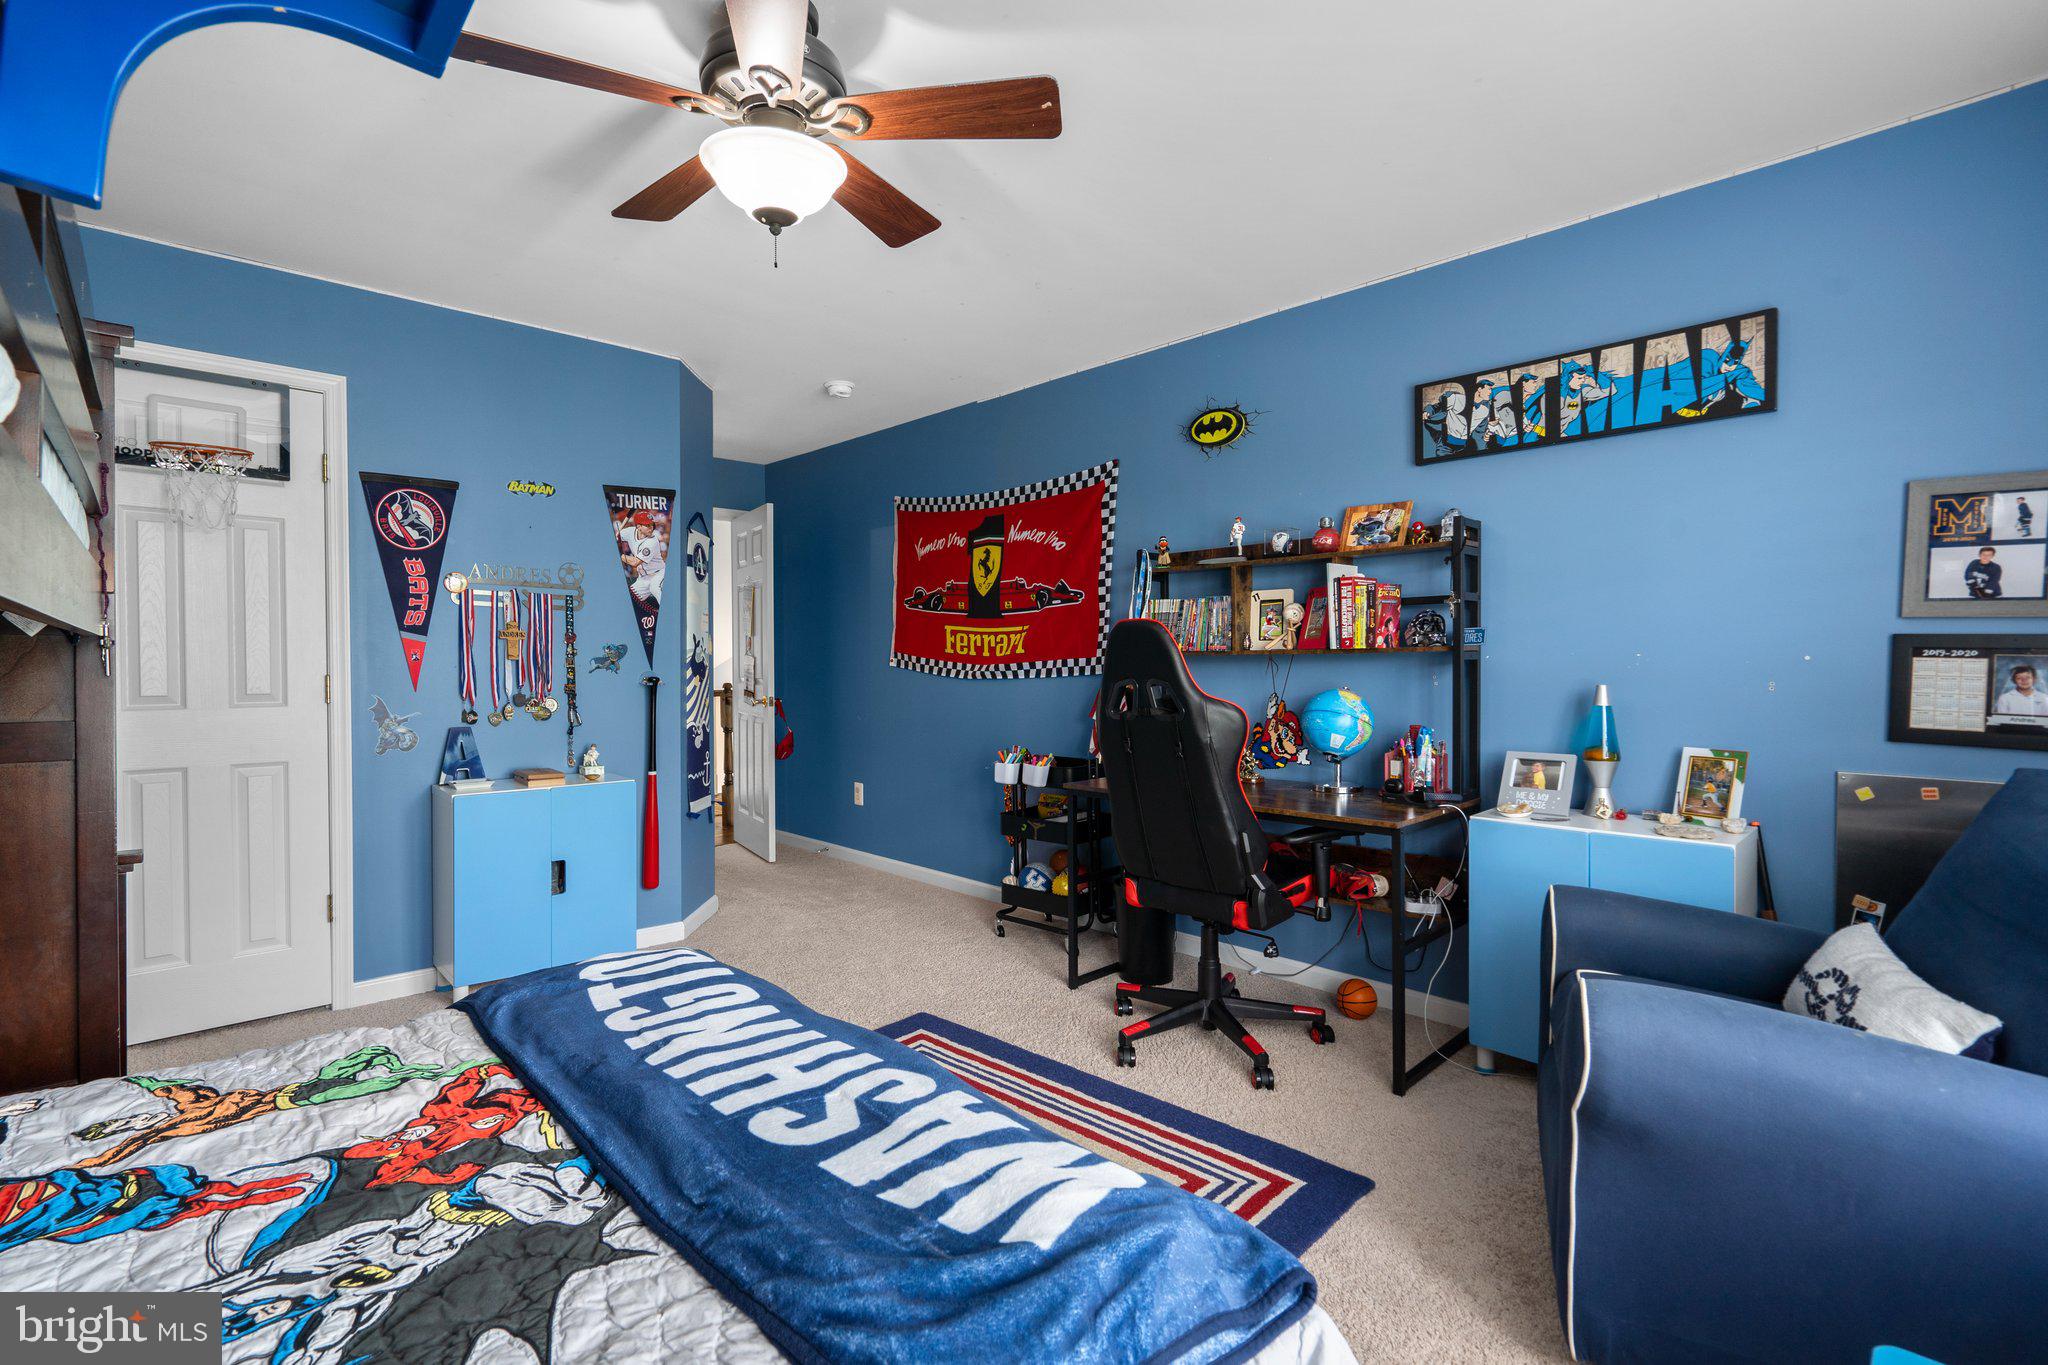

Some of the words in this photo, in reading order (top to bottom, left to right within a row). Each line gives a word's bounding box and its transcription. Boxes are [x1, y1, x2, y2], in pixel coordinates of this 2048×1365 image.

[1422, 315, 1766, 459] BATMAN
[508, 481, 554, 495] BATMAN
[412, 492, 443, 533] LOUISVILLE
[616, 493, 667, 511] TURNER
[380, 517, 396, 539] BATS
[467, 562, 552, 585] ANDRES
[402, 556, 430, 626] BATS
[641, 615, 655, 629] W
[944, 625, 1031, 657] Ferrari
[1922, 649, 1979, 657] 2019-2020
[576, 949, 1146, 1250] WASHINGTO
